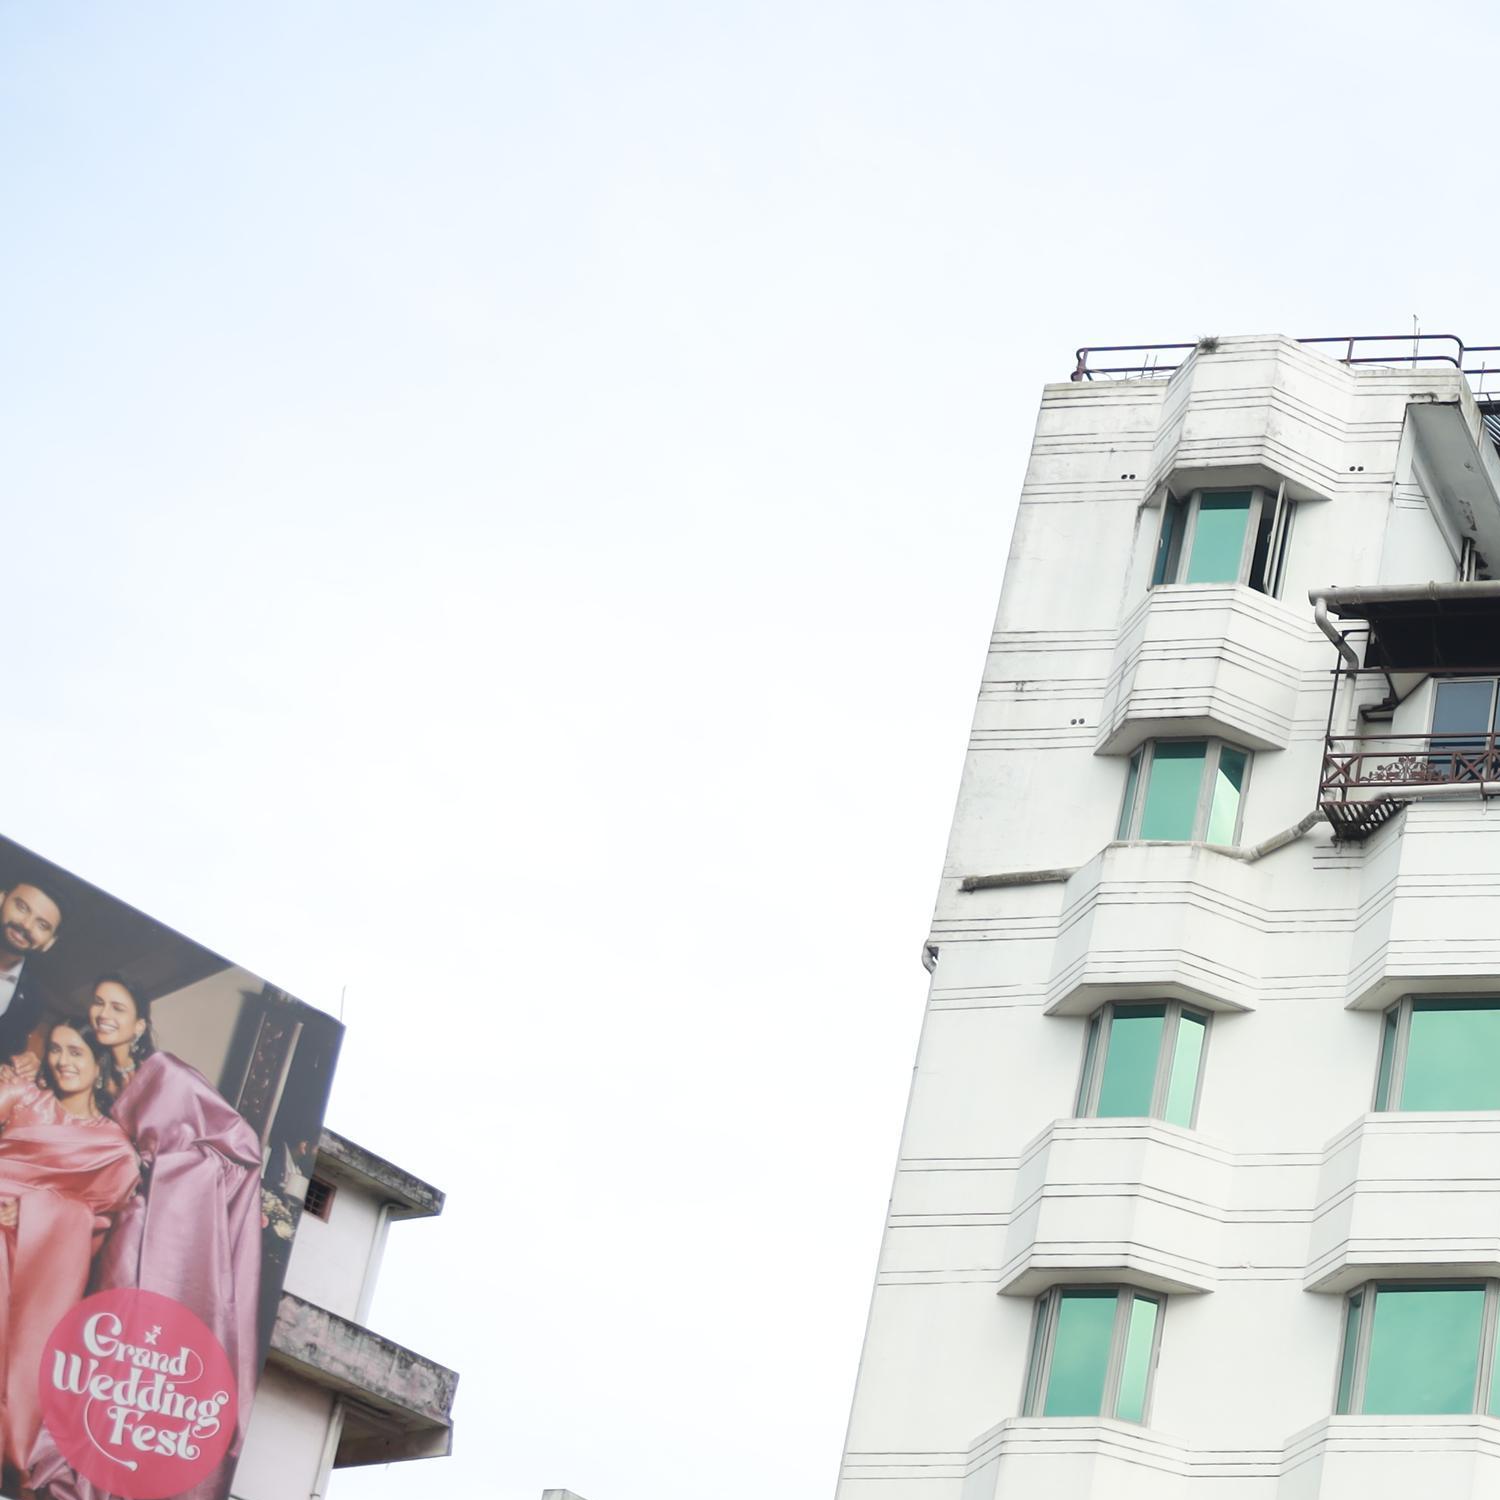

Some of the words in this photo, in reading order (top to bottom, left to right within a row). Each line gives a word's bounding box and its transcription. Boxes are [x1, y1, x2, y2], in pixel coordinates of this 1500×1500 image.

[84, 1313, 202, 1382] Grand
[53, 1350, 229, 1438] Wedding
[107, 1406, 200, 1461] Fest
